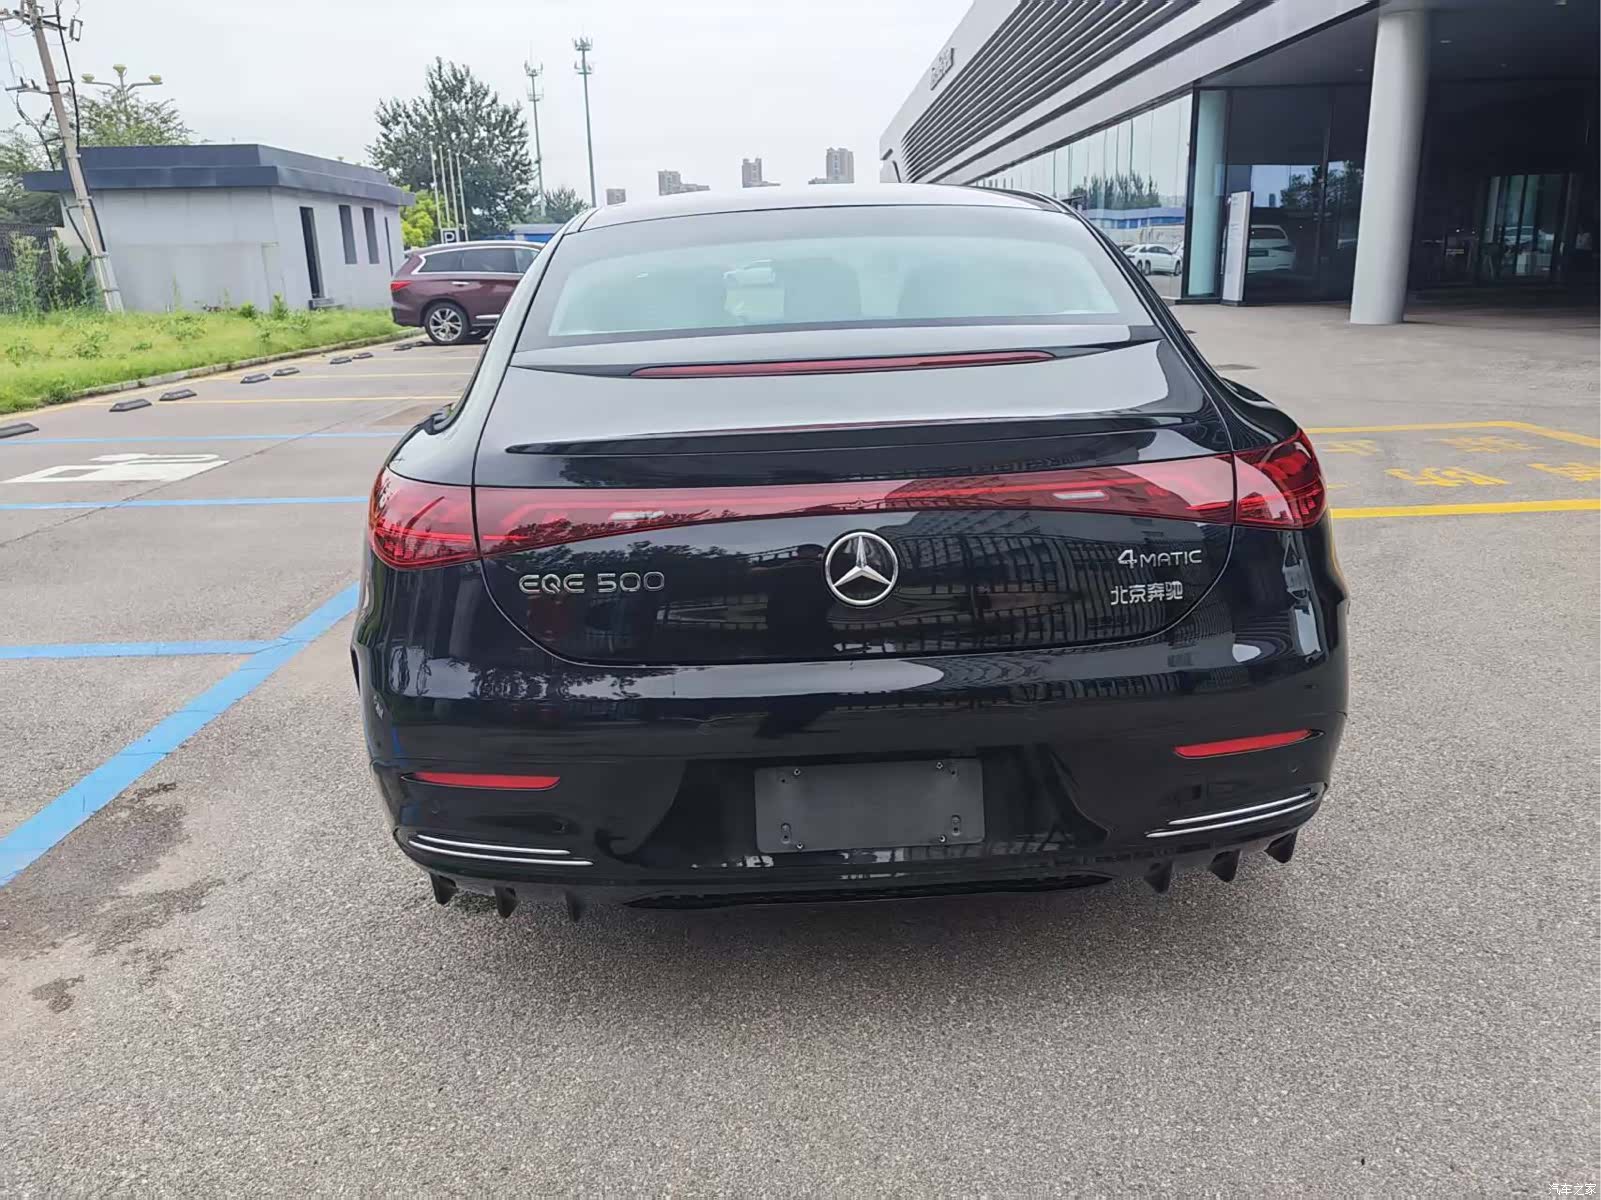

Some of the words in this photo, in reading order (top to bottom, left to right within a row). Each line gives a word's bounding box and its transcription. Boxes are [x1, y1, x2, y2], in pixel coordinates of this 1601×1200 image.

[444, 231, 455, 243] P
[518, 573, 585, 594] EQE
[597, 571, 665, 593] 500
[1110, 581, 1183, 605] 北京奔驰
